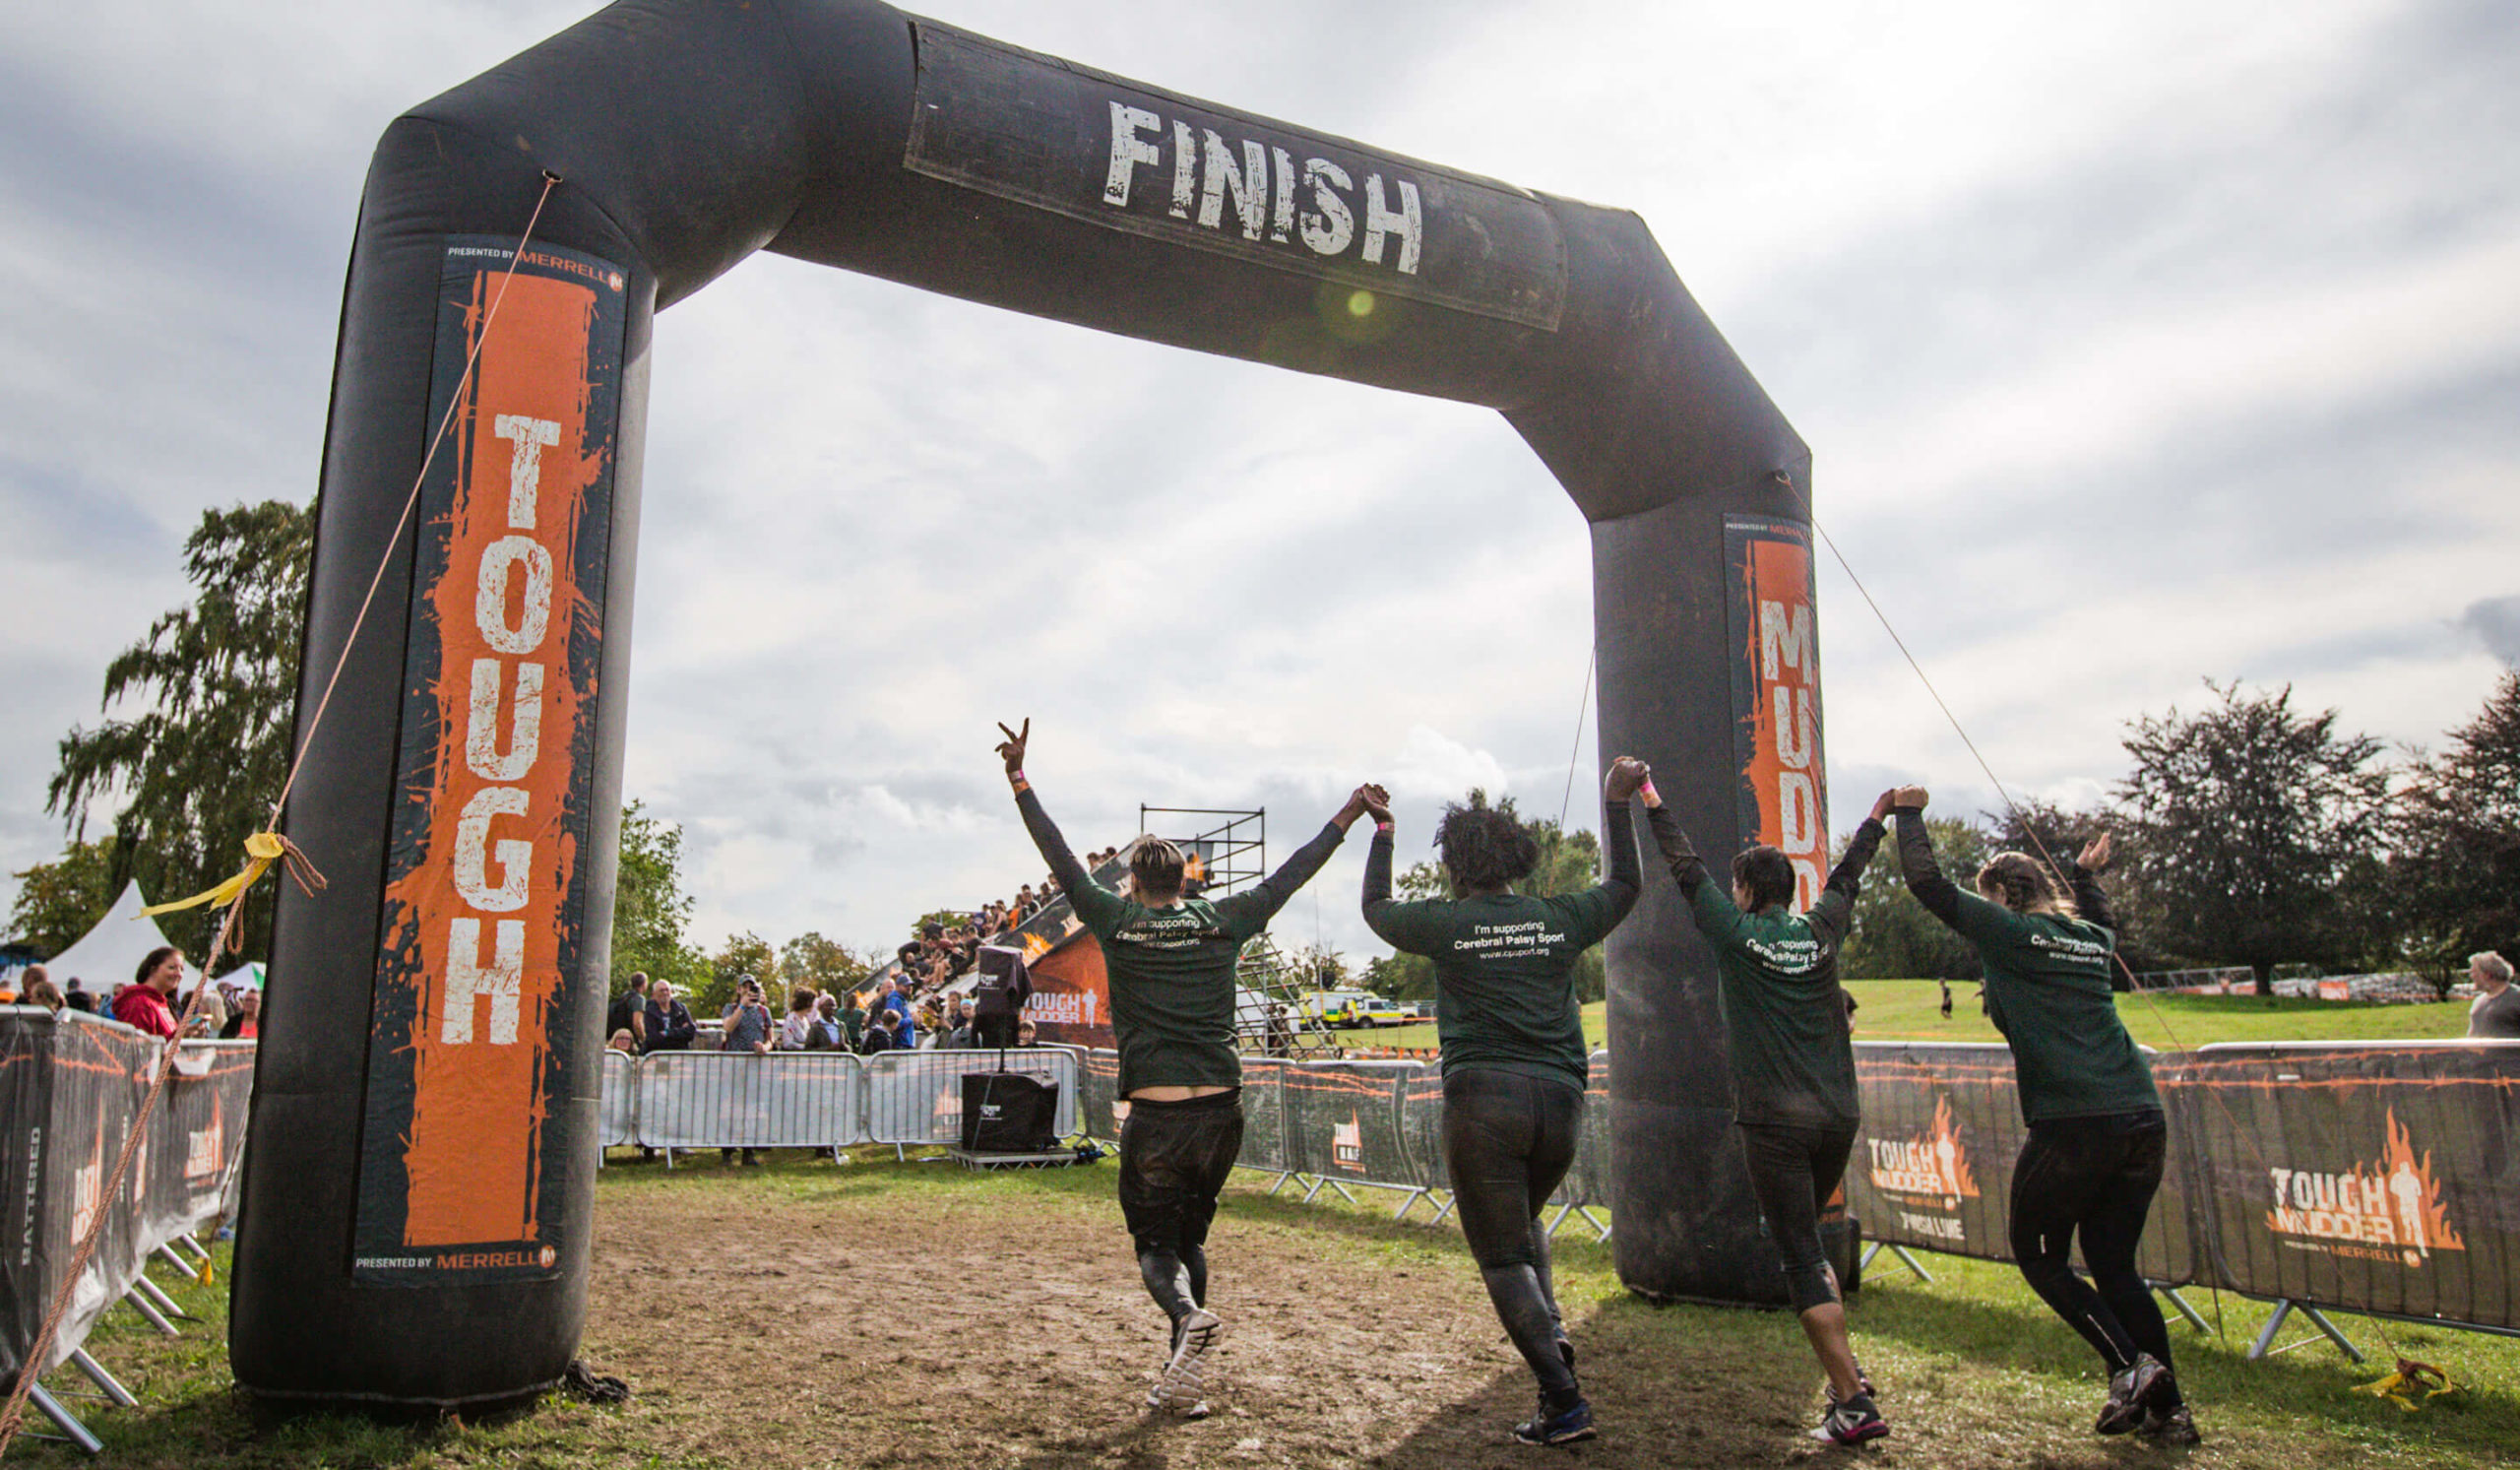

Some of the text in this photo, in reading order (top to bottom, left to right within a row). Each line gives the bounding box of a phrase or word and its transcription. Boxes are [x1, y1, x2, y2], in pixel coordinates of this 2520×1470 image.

[1102, 100, 1423, 276] FINISH
[448, 246, 500, 258] PRESENTED
[501, 250, 515, 260] BY
[518, 251, 608, 285] MERRELL
[441, 414, 561, 1046] TOUGH
[1760, 599, 1819, 916] MUDD
[1454, 932, 1565, 950] Cerebral Palsy Sport
[1475, 921, 1545, 935] I'm supporting
[1867, 1137, 1935, 1173] TOUGH
[21, 1126, 41, 1266] BATTERED
[1871, 1167, 1943, 1194] MUDDER
[2270, 1167, 2388, 1217] TOUGH
[2273, 1204, 2398, 1247] MUDDER
[355, 1257, 416, 1268] PRESENTED
[416, 1256, 433, 1268] BY
[436, 1250, 539, 1270] MERRELL
